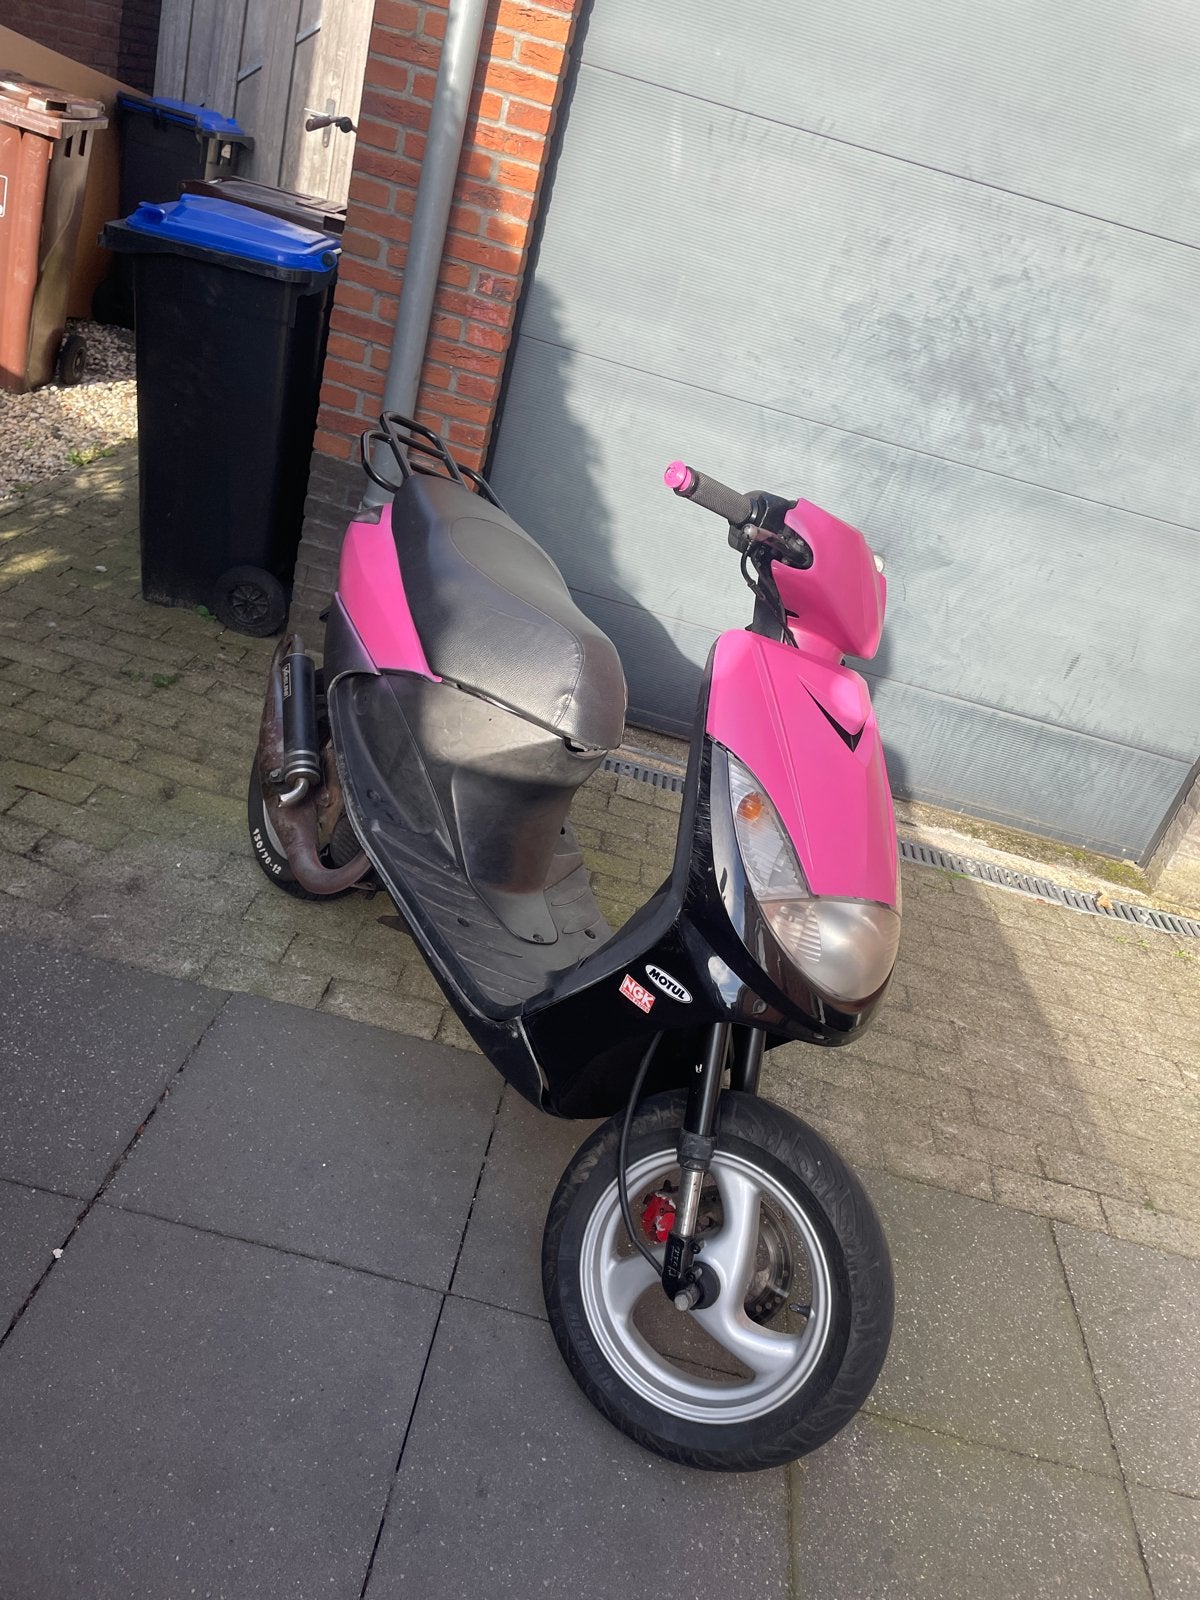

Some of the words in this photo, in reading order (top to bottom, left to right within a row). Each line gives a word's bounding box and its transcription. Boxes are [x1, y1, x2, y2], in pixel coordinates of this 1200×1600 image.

[253, 828, 282, 874] 130/70-12
[624, 976, 653, 1007] NGK
[649, 969, 685, 999] MOTUL
[564, 1303, 618, 1394] MICHELIN
